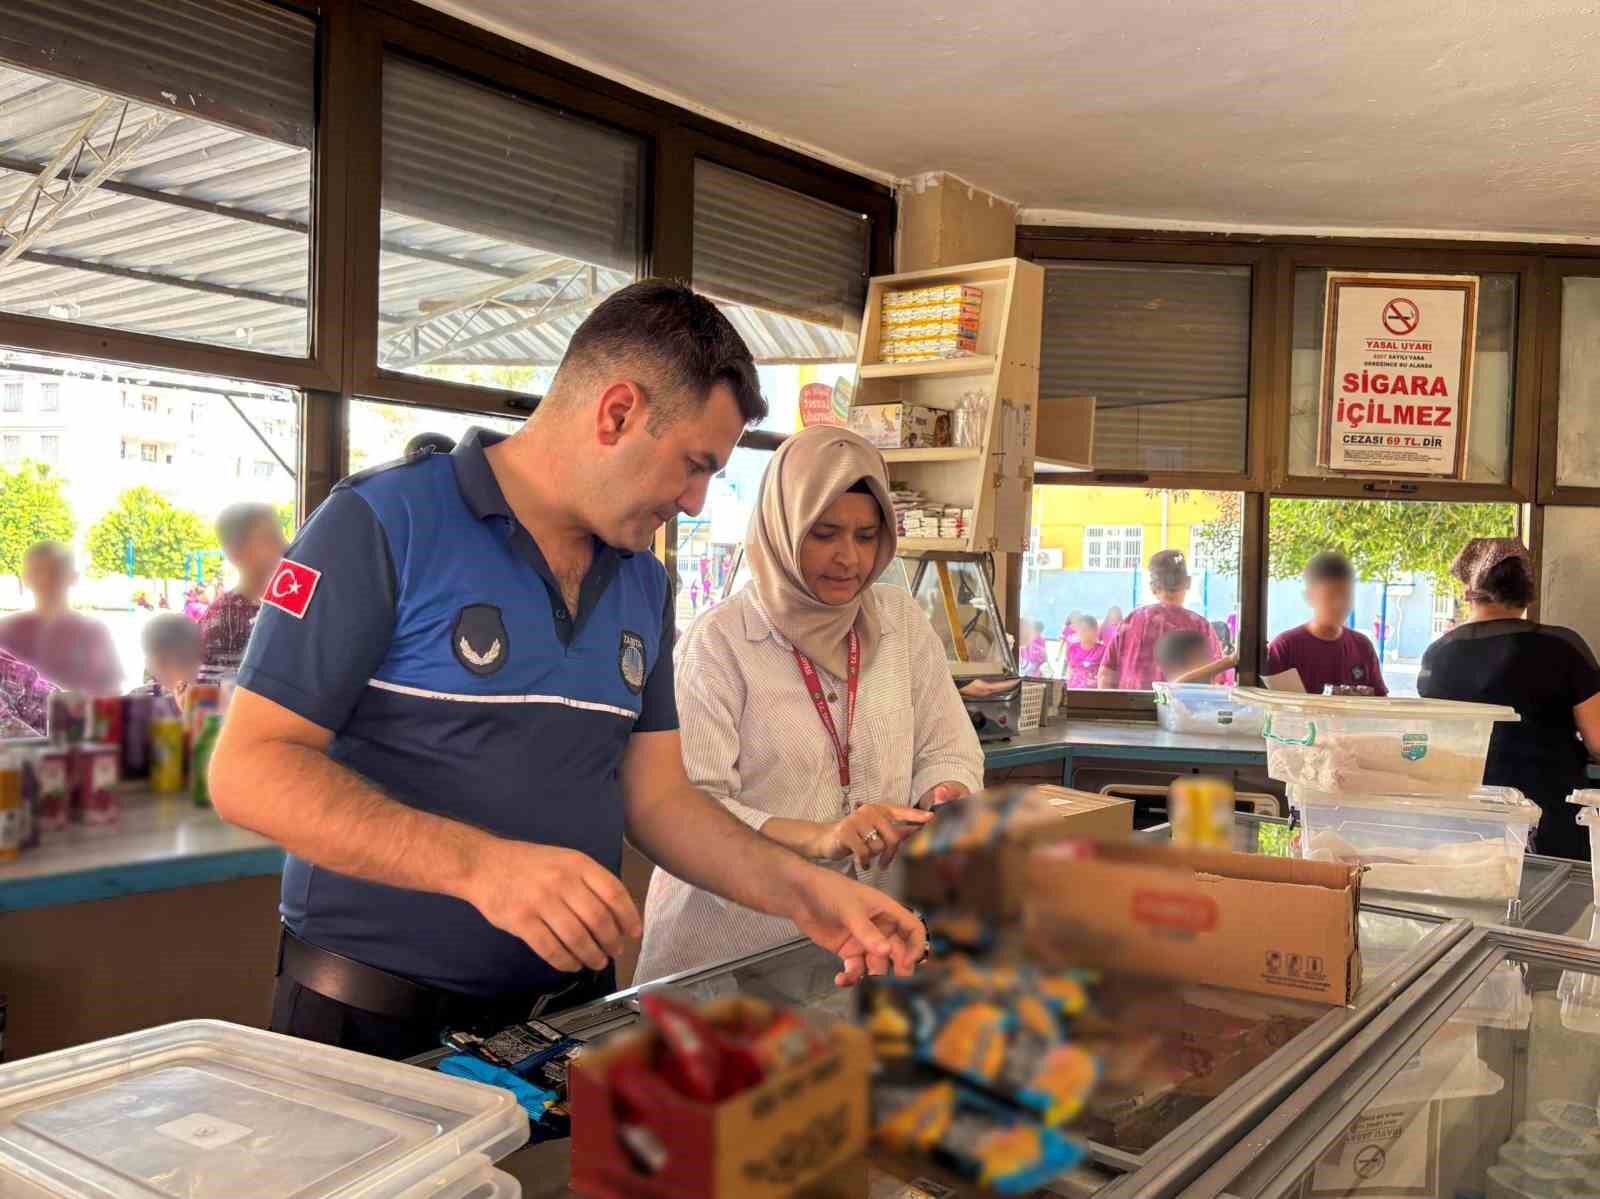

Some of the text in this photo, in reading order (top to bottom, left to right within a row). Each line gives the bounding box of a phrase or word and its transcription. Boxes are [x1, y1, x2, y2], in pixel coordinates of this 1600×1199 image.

[1366, 341, 1432, 351] YASAL UYARI
[1342, 369, 1449, 397] SİGARA
[1336, 397, 1452, 429] İÇİLMEZ
[1343, 434, 1383, 444] CEZASI
[1386, 436, 1401, 445] 69
